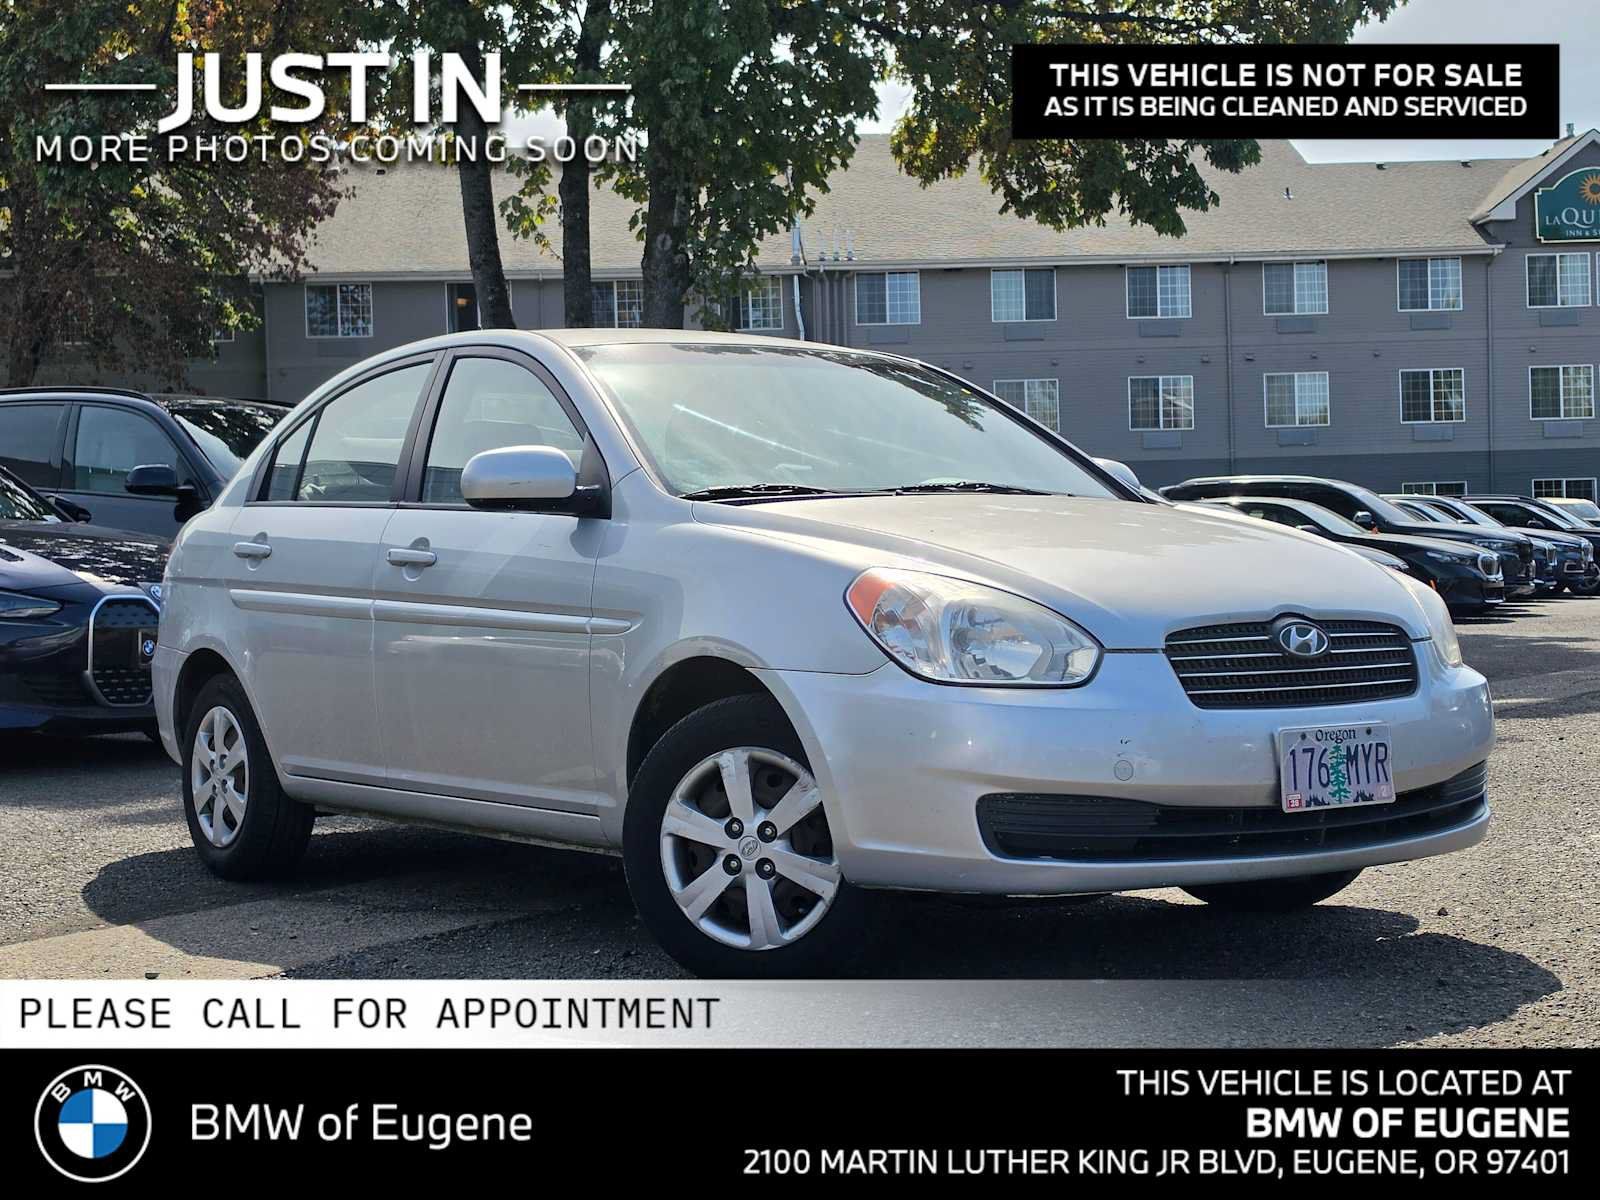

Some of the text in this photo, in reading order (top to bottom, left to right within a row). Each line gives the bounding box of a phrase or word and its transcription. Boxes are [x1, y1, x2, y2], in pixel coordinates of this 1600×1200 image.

[1561, 207, 1600, 229] QU
[1315, 728, 1356, 744] Oregon
[1290, 742, 1389, 791] 176 MYR
